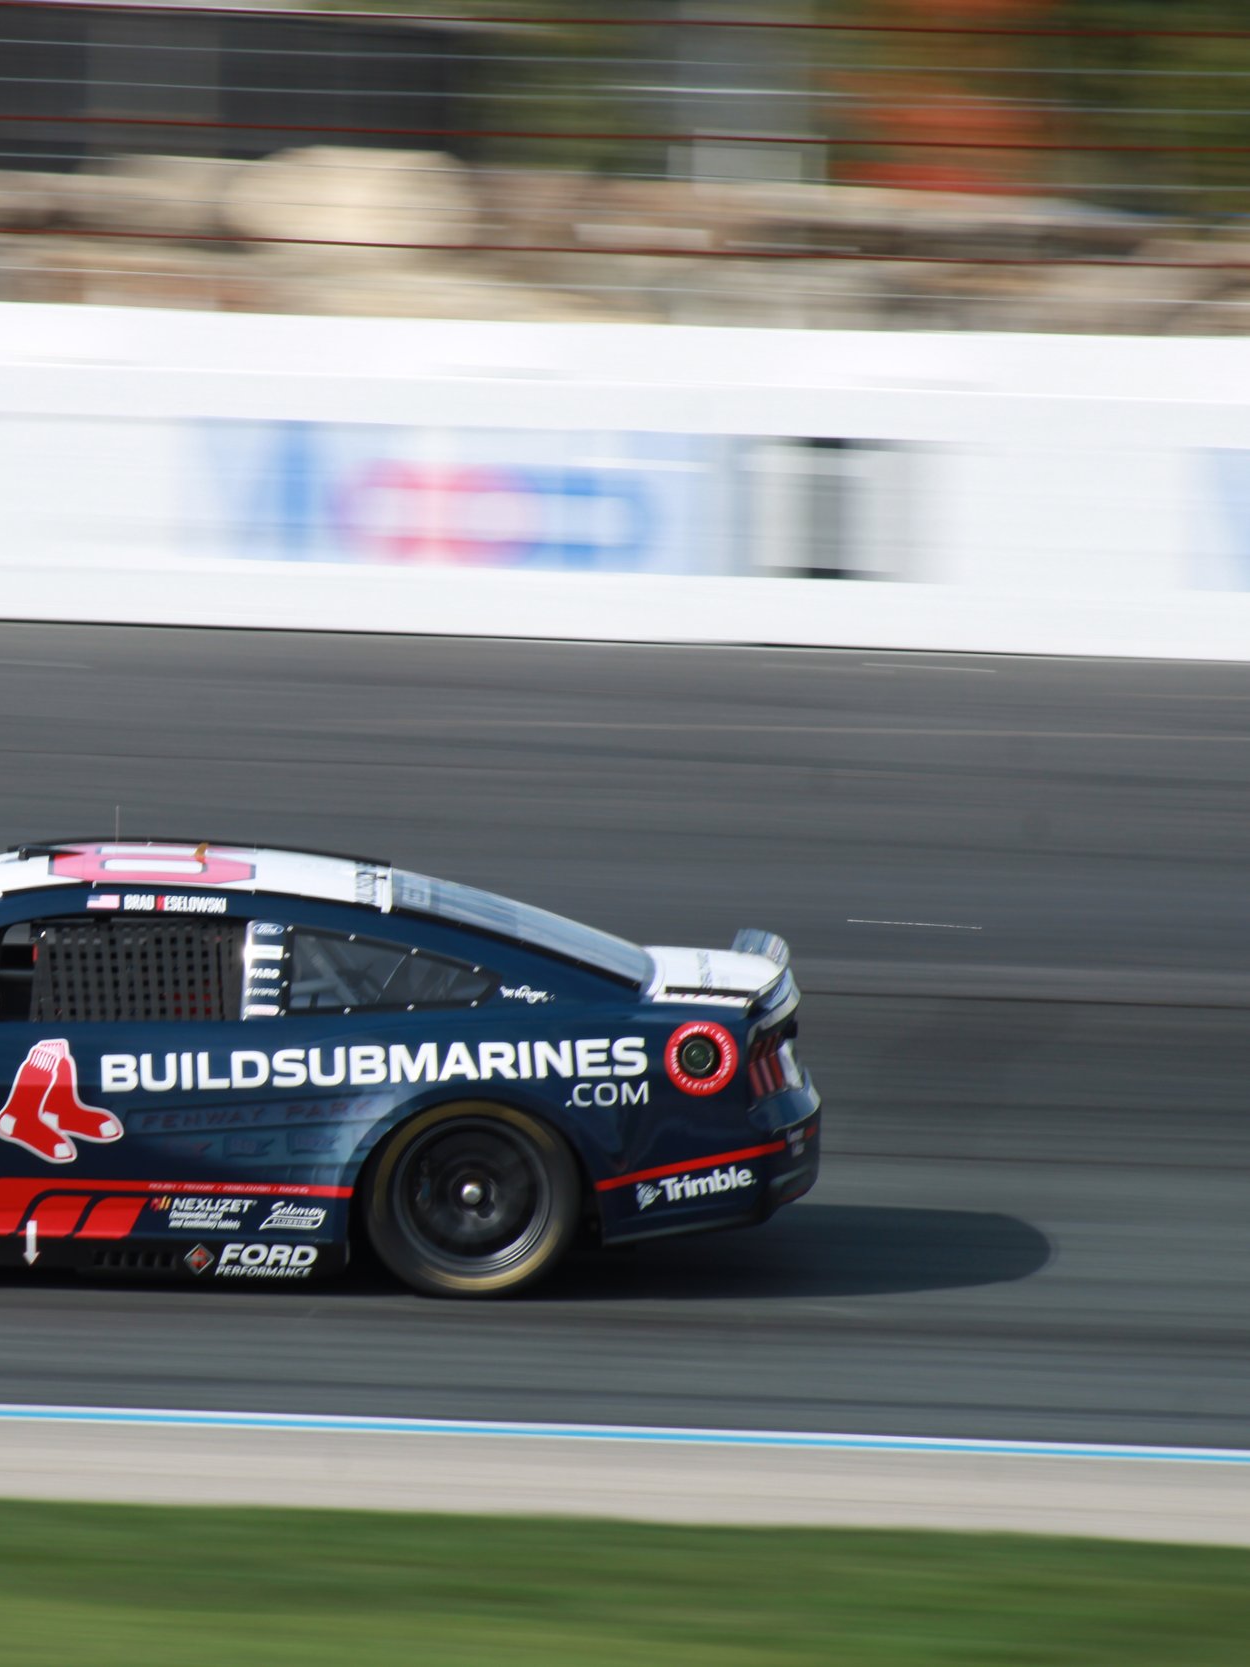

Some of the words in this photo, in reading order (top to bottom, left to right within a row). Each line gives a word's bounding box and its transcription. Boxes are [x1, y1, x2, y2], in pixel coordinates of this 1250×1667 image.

[124, 894, 155, 911] BRAD
[101, 1036, 648, 1093] BUILDSUBMARINES
[565, 1081, 649, 1108] .COM
[659, 1166, 753, 1202] Trimble
[171, 1198, 254, 1213] NEXLIZET
[219, 1243, 318, 1267] FORD
[215, 1265, 312, 1278] PERFORMANCE
